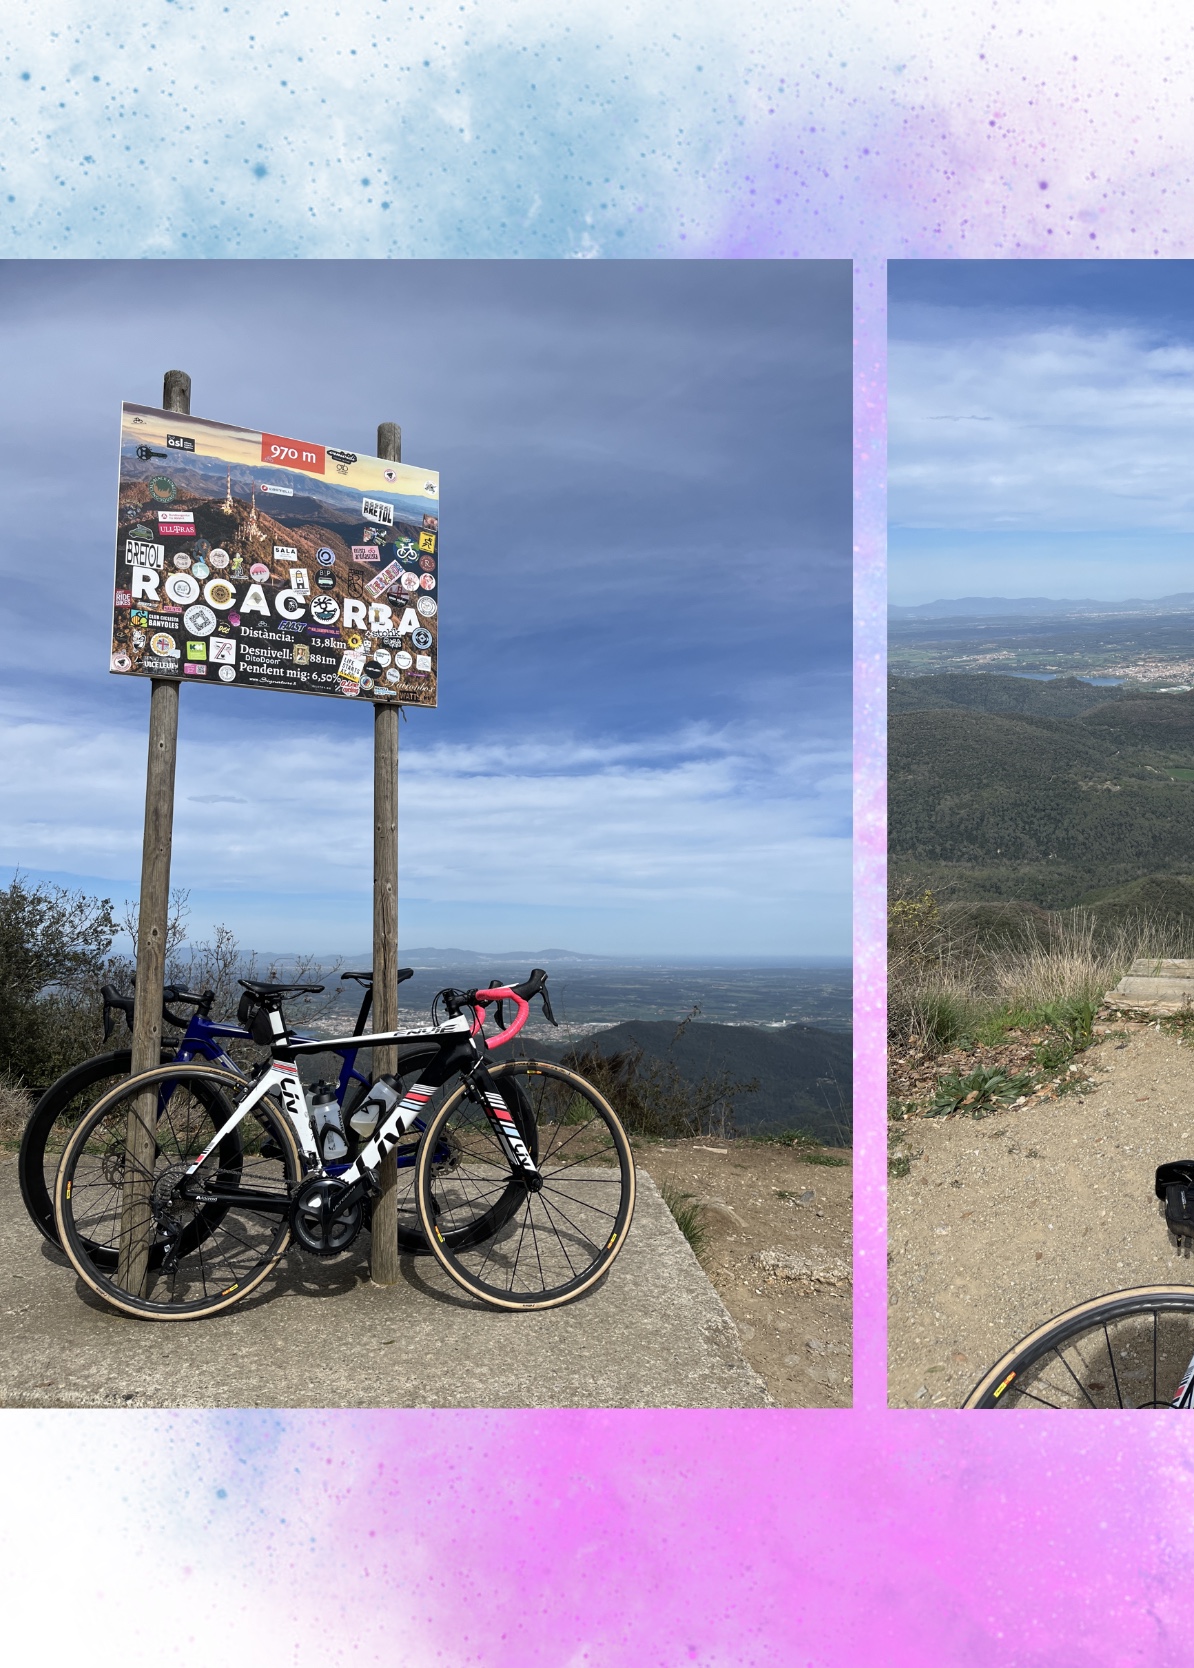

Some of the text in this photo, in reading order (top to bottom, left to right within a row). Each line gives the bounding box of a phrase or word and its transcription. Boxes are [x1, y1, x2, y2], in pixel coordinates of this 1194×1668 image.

[270, 445, 299, 460] 970
[302, 451, 317, 464] m
[148, 620, 179, 630] BANYOLES
[240, 626, 295, 643] Distància:
[311, 637, 347, 650] 13,8km
[240, 644, 336, 666] Desnivell: 881m
[239, 661, 285, 676] Pendent
[286, 668, 311, 682] mig:
[311, 672, 342, 684] 6,50%
